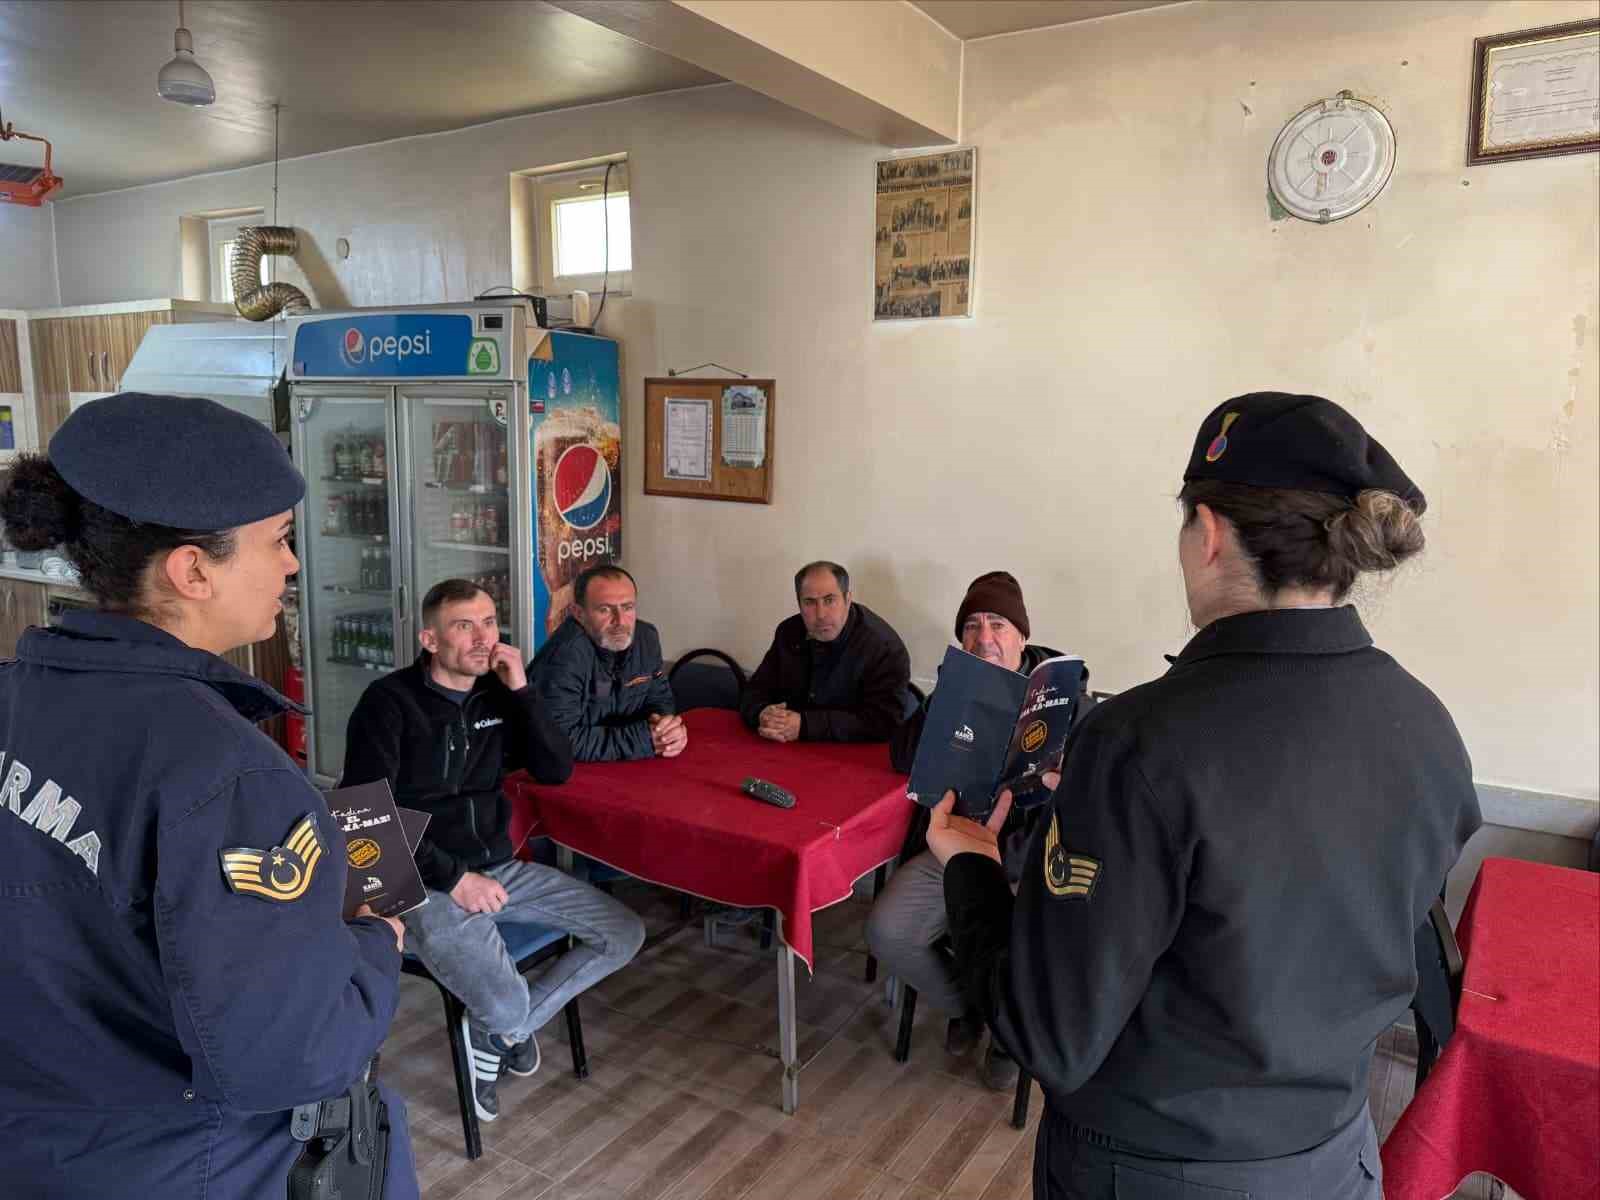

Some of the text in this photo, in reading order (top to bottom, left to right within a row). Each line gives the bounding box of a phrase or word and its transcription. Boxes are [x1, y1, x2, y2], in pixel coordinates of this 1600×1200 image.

[370, 329, 431, 361] pepsi
[558, 532, 609, 565] pepsi
[0, 751, 101, 876] RMA
[347, 815, 360, 824] EL
